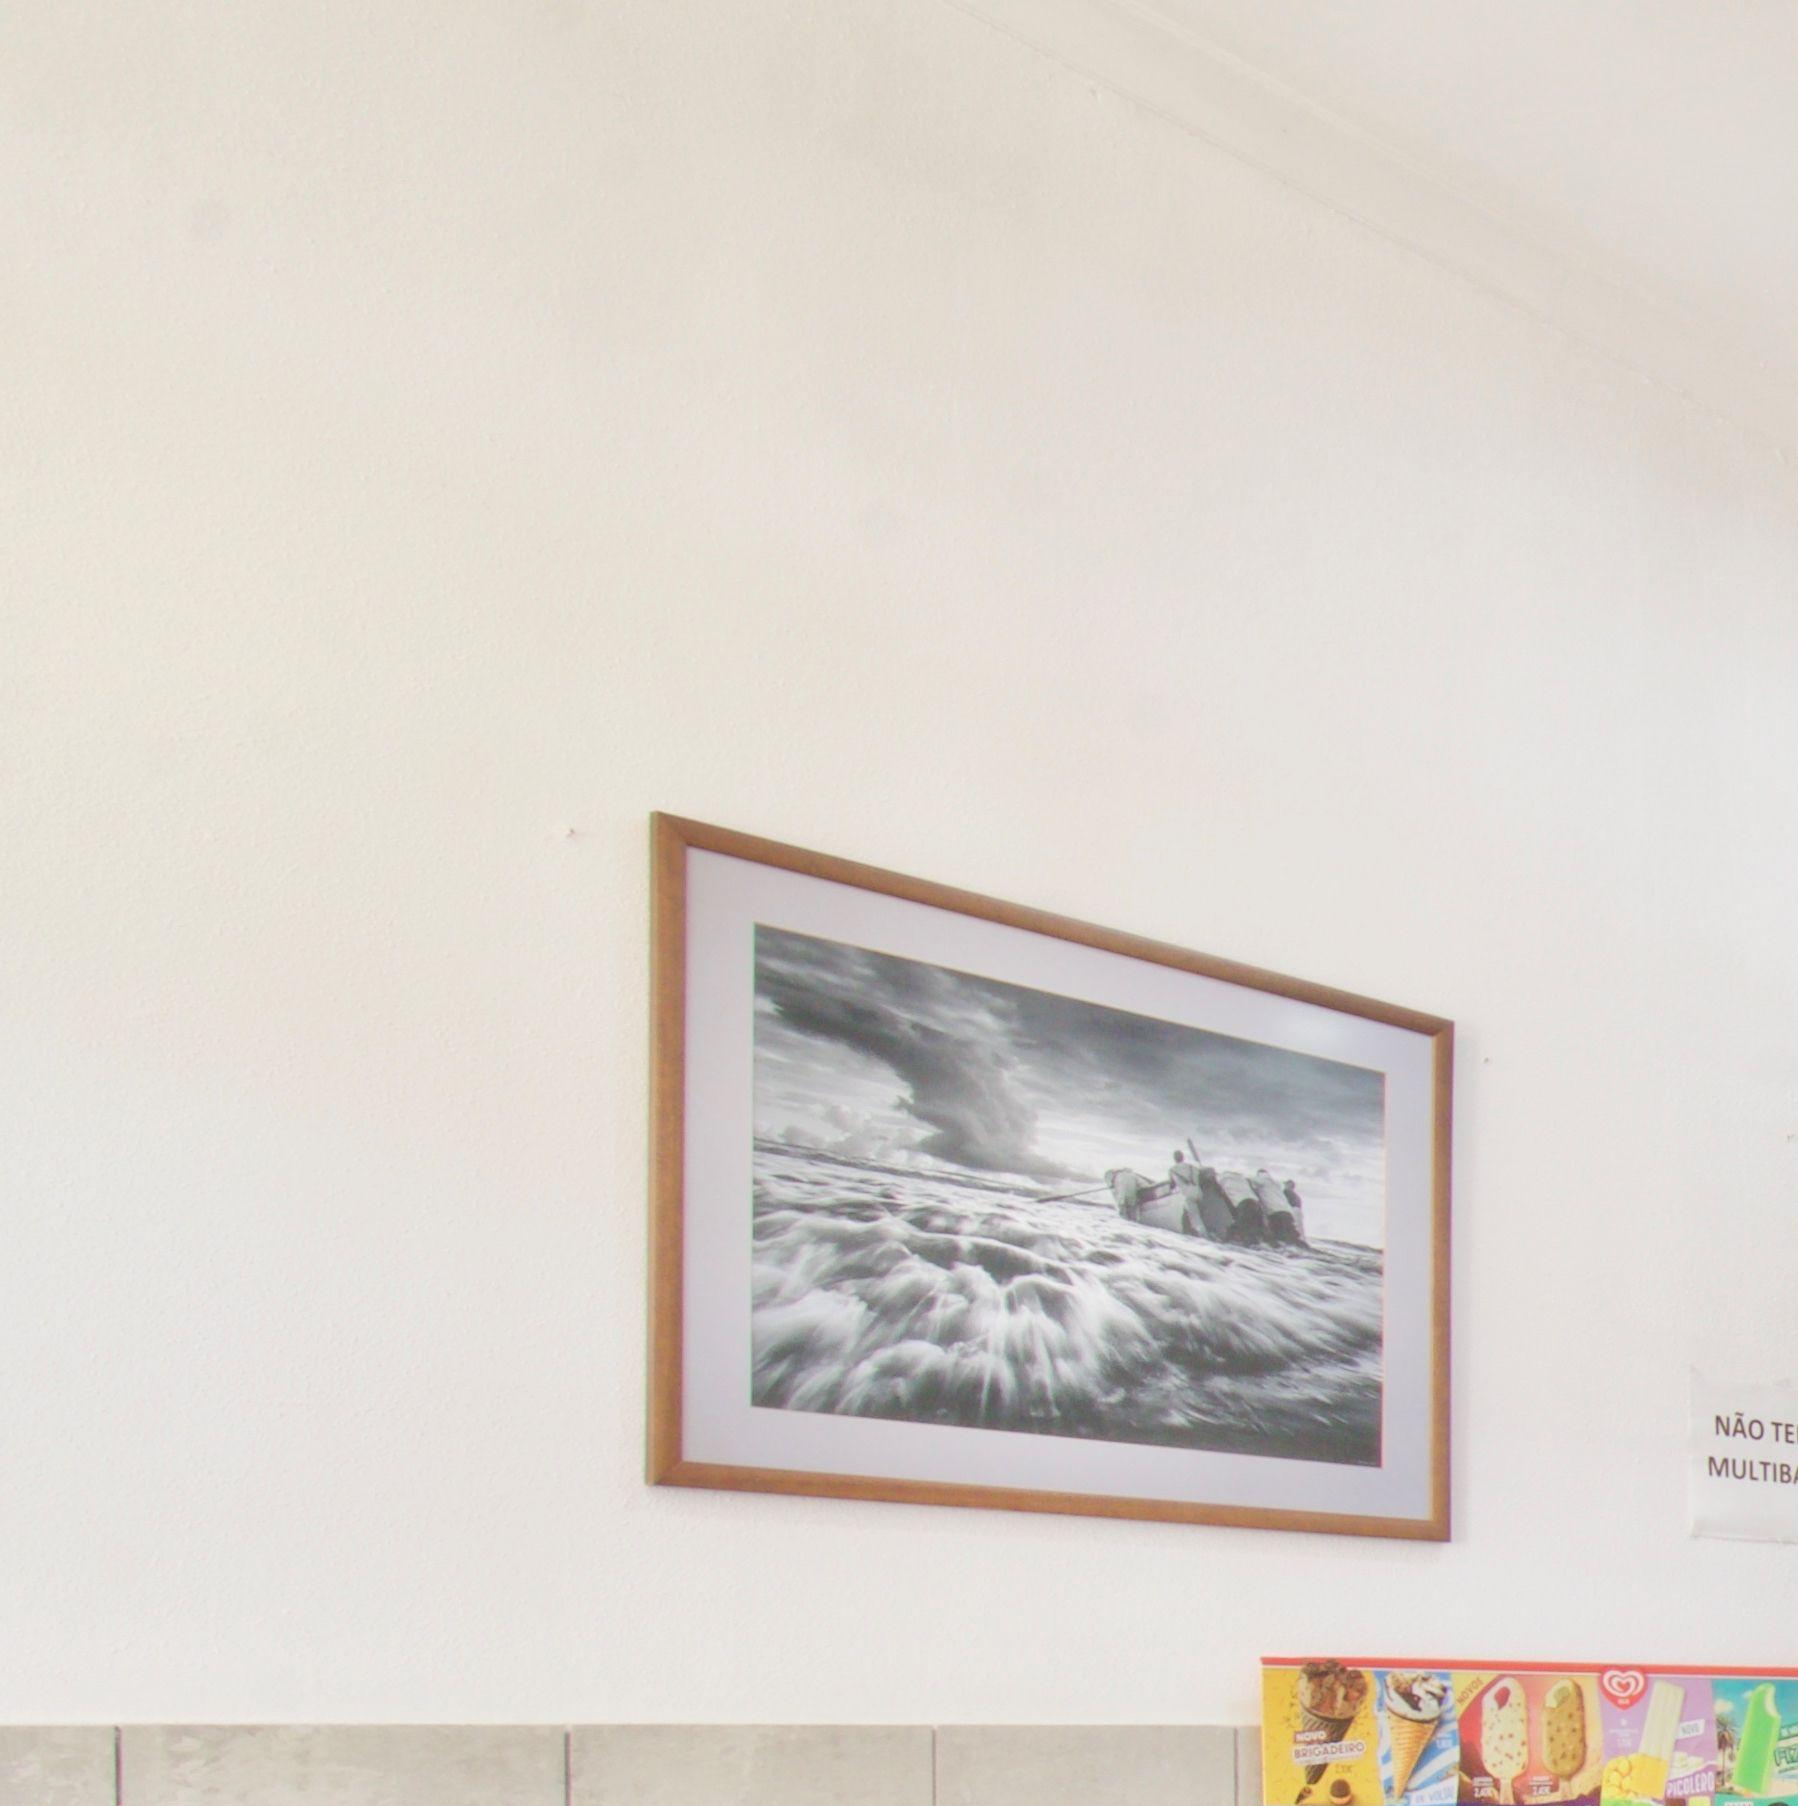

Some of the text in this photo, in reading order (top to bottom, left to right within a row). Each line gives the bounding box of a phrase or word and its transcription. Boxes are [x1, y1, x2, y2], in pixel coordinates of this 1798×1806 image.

[1714, 1411, 1764, 1440] NÃO
[1294, 1742, 1365, 1759] BRIGADEIRO
[1666, 1770, 1716, 1797] PICOLERO
